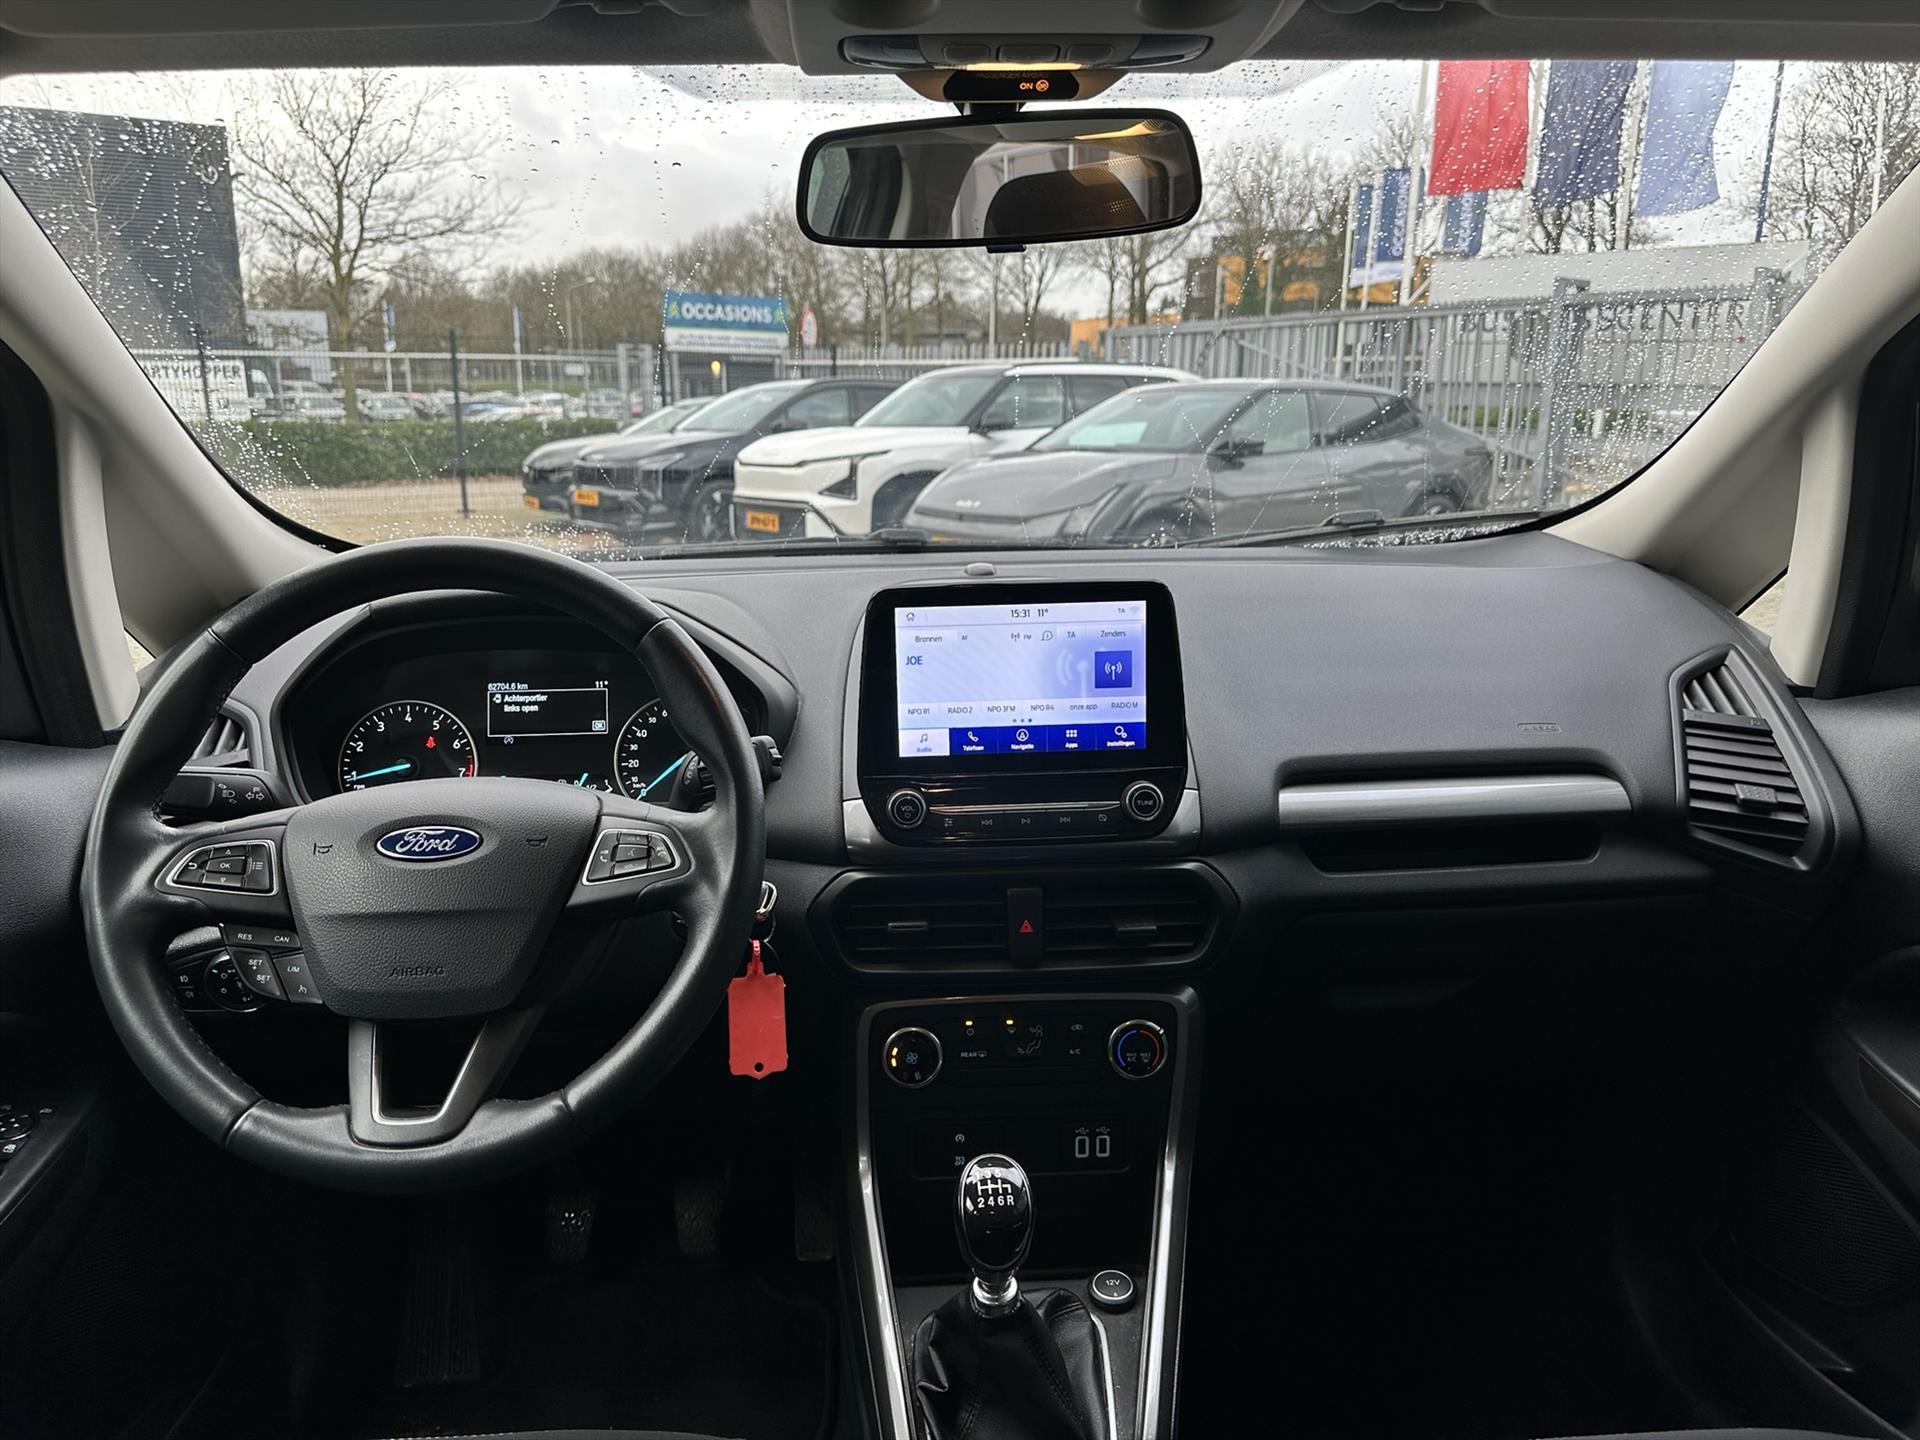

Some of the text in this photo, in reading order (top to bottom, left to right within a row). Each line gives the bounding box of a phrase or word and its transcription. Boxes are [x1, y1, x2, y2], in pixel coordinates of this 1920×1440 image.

[1019, 82, 1033, 90] ON
[680, 301, 773, 324] OCCASIONS
[1010, 609, 1030, 618] 15:31
[914, 635, 943, 643] Bronnen
[1100, 630, 1127, 638] Zenders
[905, 655, 924, 666] JOE
[487, 682, 529, 691] 62704.6 km
[503, 694, 548, 704] Achterportier
[521, 705, 539, 713] open
[947, 706, 968, 714] RADIO
[404, 713, 412, 723] 4
[377, 721, 385, 732] 3
[432, 720, 440, 731] 5
[636, 729, 648, 738] 40
[356, 741, 364, 752] 2
[452, 738, 461, 749] 6
[629, 743, 638, 751] 30
[628, 759, 640, 768] 20
[351, 770, 357, 781] 1
[458, 767, 466, 778] 7
[395, 829, 460, 853] Ford
[287, 965, 300, 973] LIM
[388, 966, 445, 977] AIRBAG
[977, 1195, 1014, 1208] 2 4 6 R
